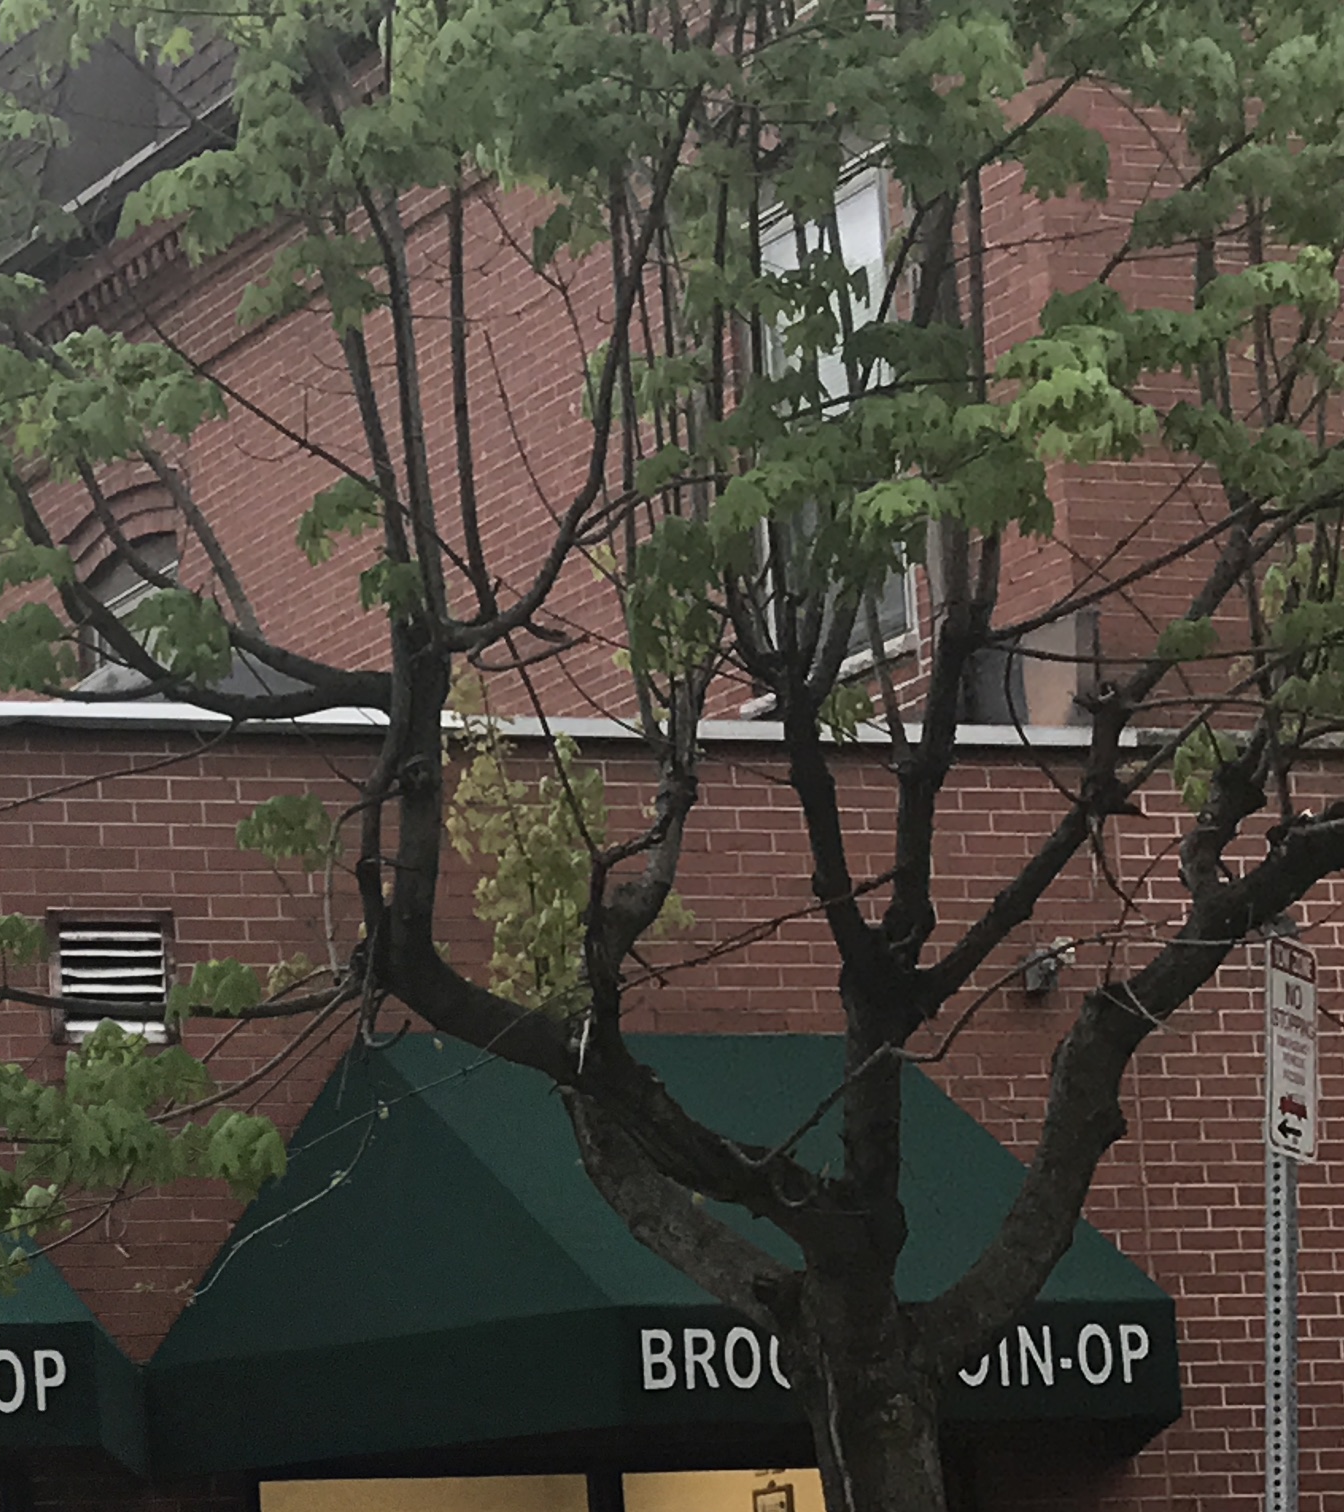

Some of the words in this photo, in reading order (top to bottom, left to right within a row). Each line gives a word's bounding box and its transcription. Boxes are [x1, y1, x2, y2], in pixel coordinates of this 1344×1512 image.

[1285, 981, 1302, 1010] NO
[641, 1326, 791, 1390] BRO
[958, 1323, 1150, 1387] IN-OP
